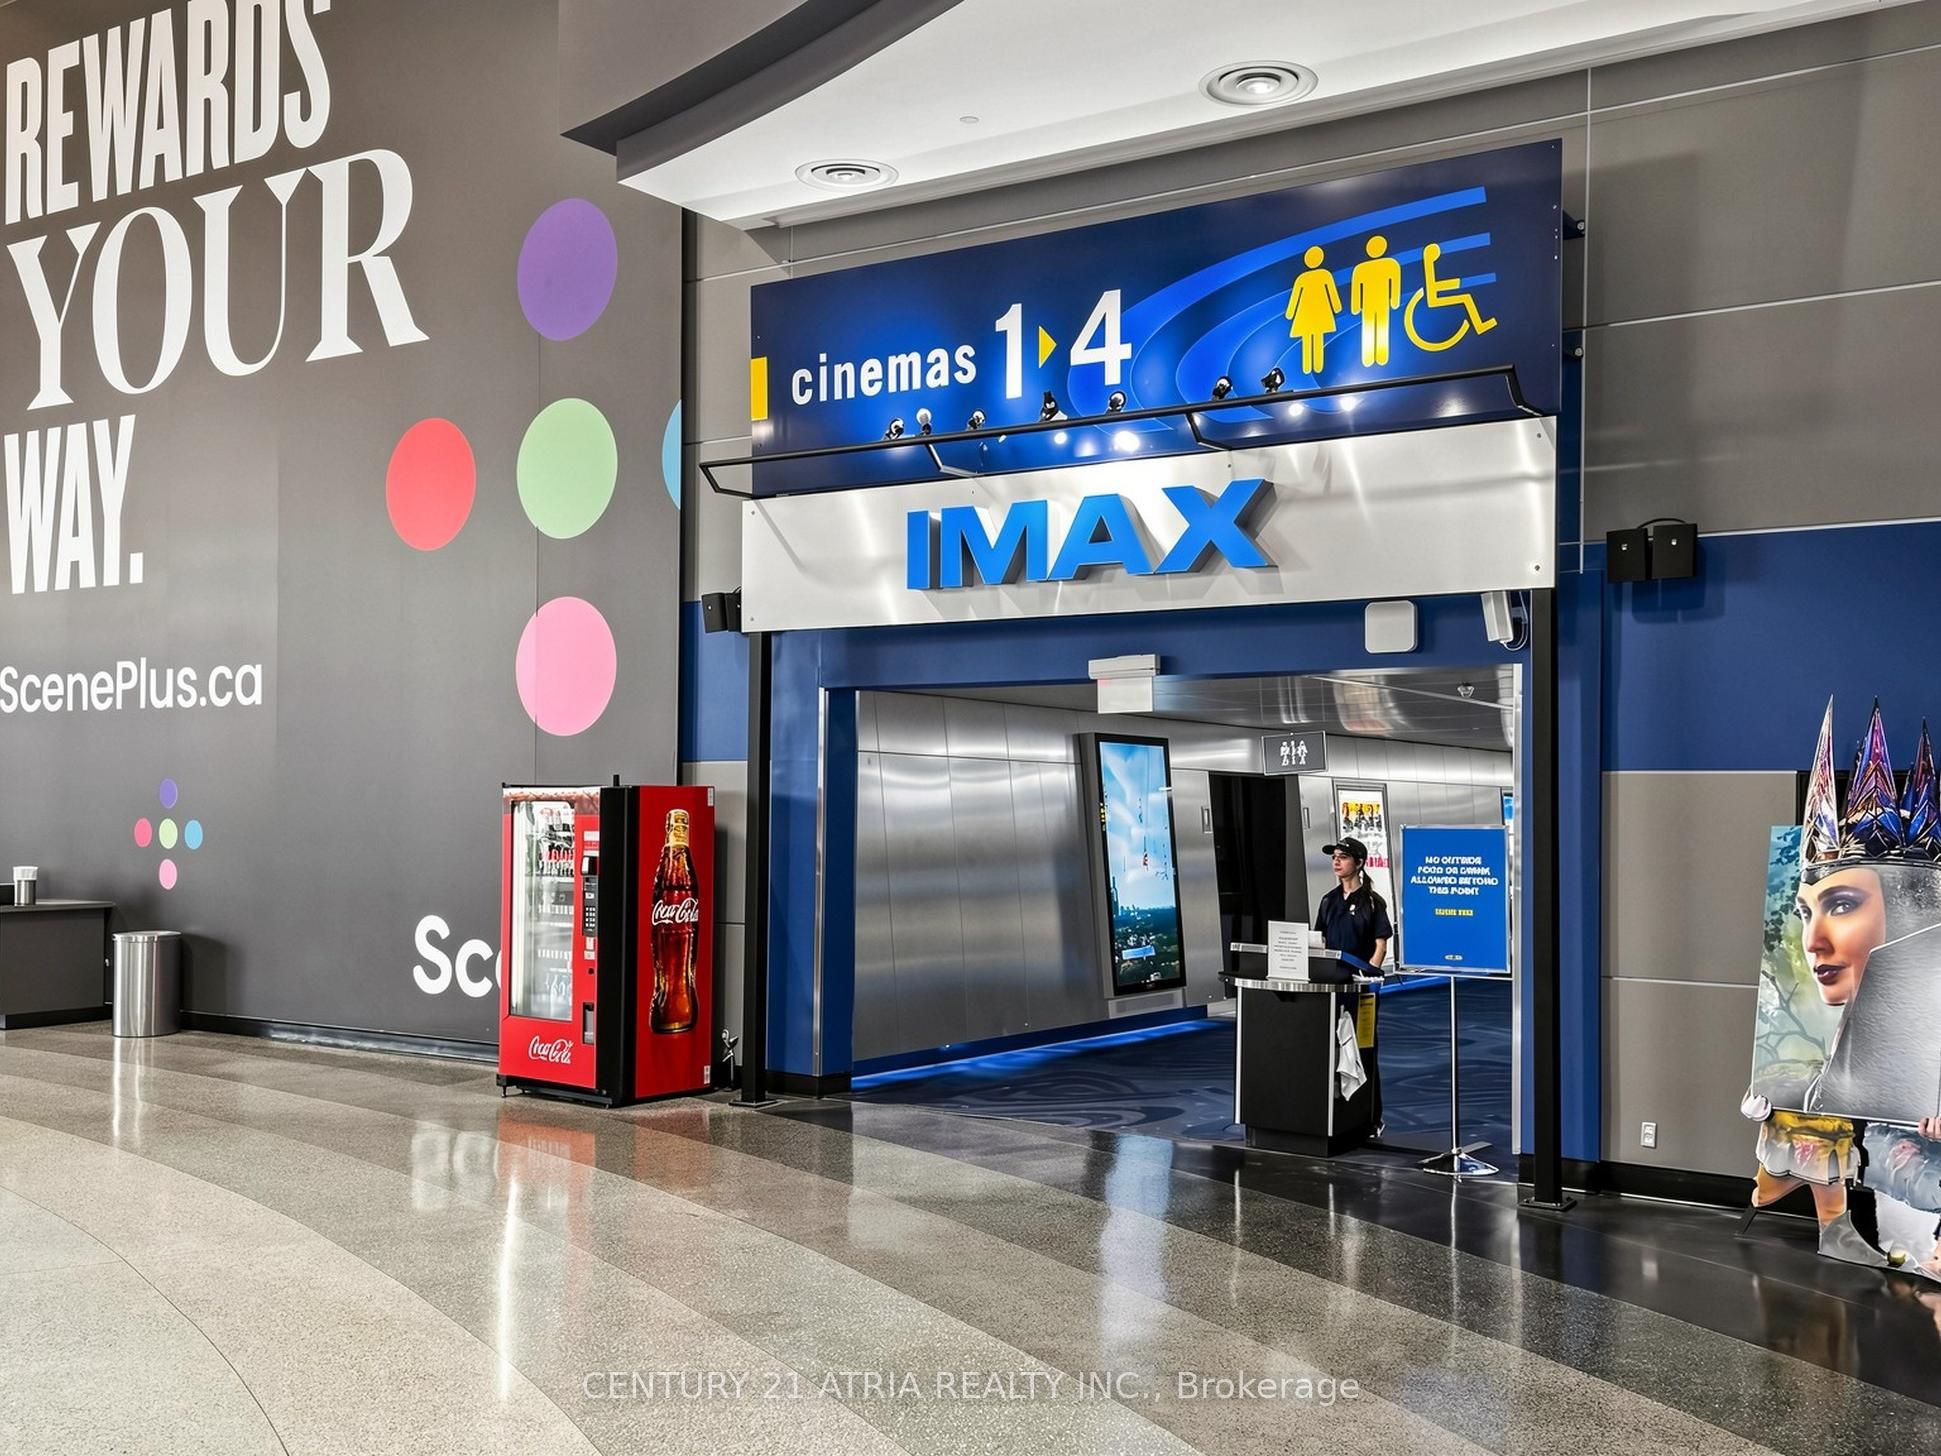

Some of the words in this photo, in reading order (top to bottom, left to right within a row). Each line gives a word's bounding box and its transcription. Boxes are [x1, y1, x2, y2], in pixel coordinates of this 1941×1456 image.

[5, 0, 331, 225] REWARDS
[6, 148, 430, 410] YOUR
[792, 344, 976, 405] cinemas
[995, 303, 1022, 399] 1
[1070, 289, 1132, 386] 4
[4, 414, 143, 594] WAY.
[906, 478, 1276, 591] IMAX
[0, 657, 262, 713] ScenePlus.ca
[413, 914, 501, 998] Sc
[651, 897, 699, 926] Coca-Cola
[528, 1035, 574, 1065] Coca-Cola
